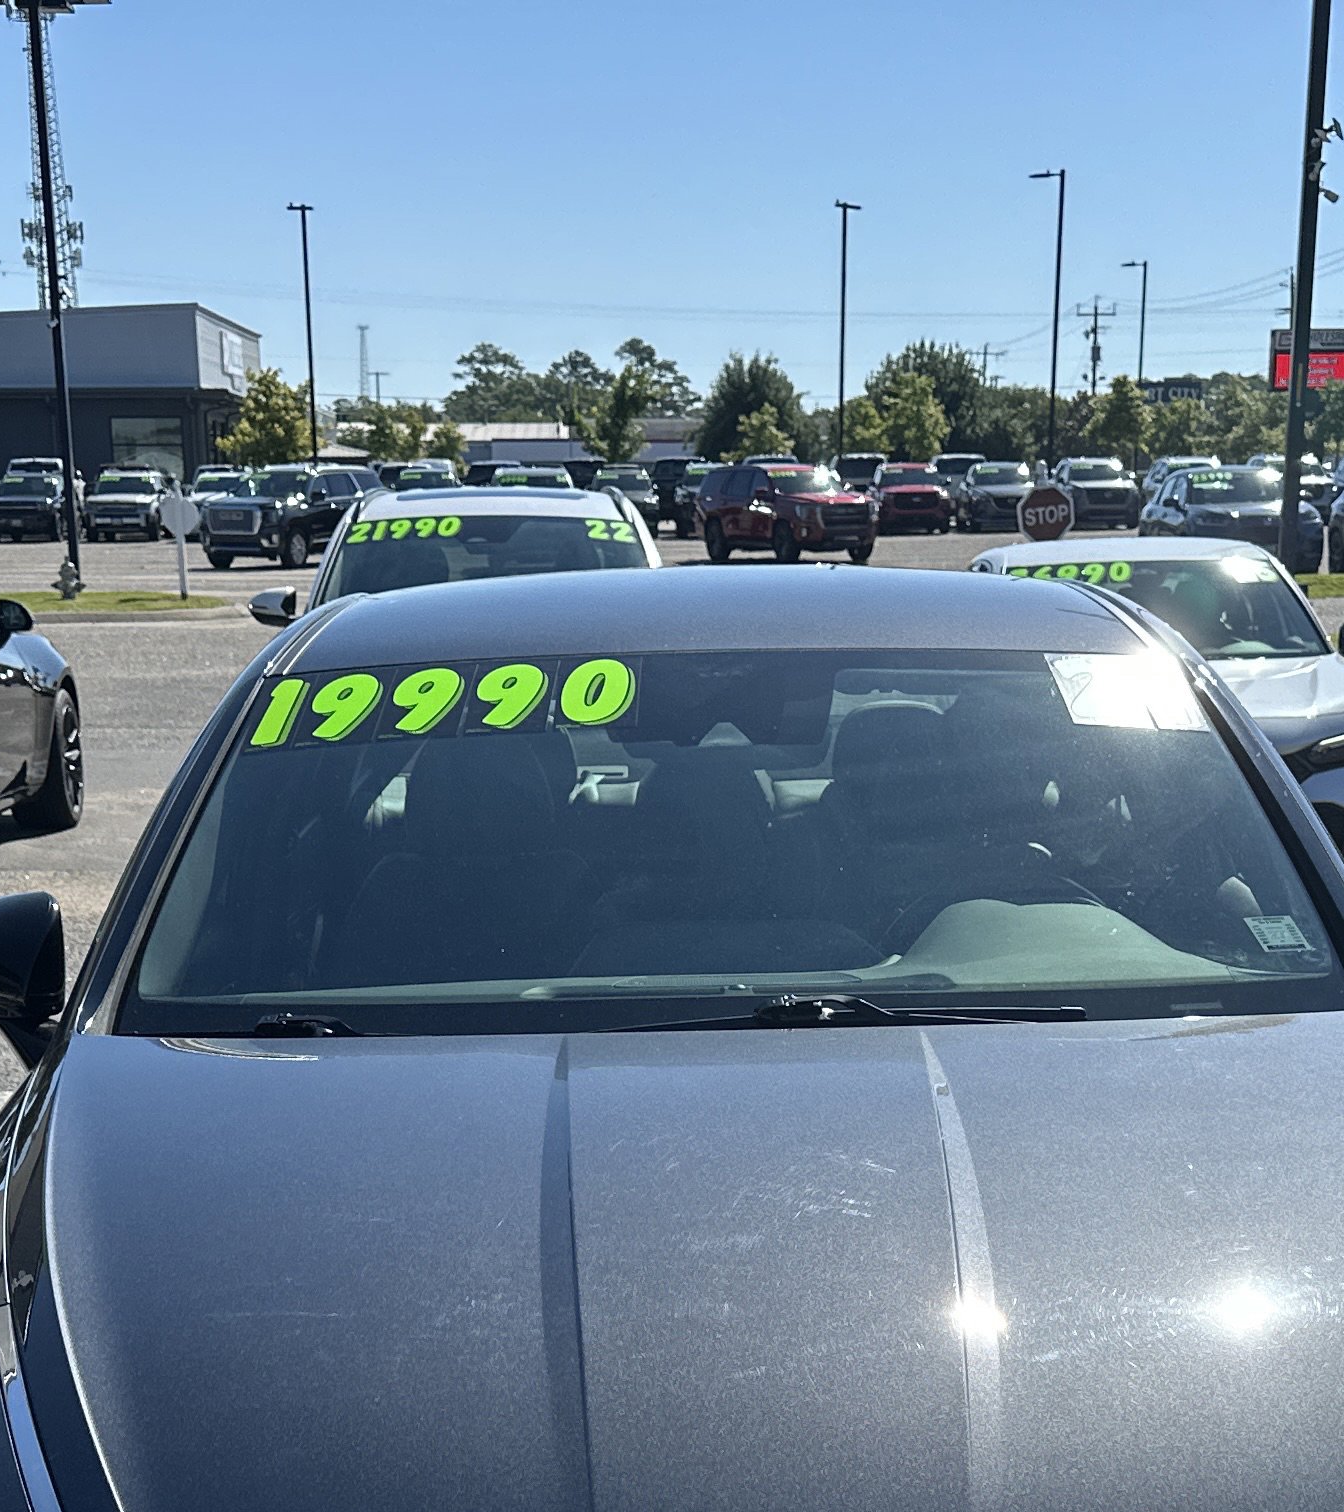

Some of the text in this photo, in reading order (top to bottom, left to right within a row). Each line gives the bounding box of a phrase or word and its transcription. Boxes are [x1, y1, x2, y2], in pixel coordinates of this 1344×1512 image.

[1168, 386, 1200, 401] CITY
[1024, 504, 1069, 527] STOP
[345, 516, 637, 544] 21990 22
[250, 659, 636, 748] 19990
